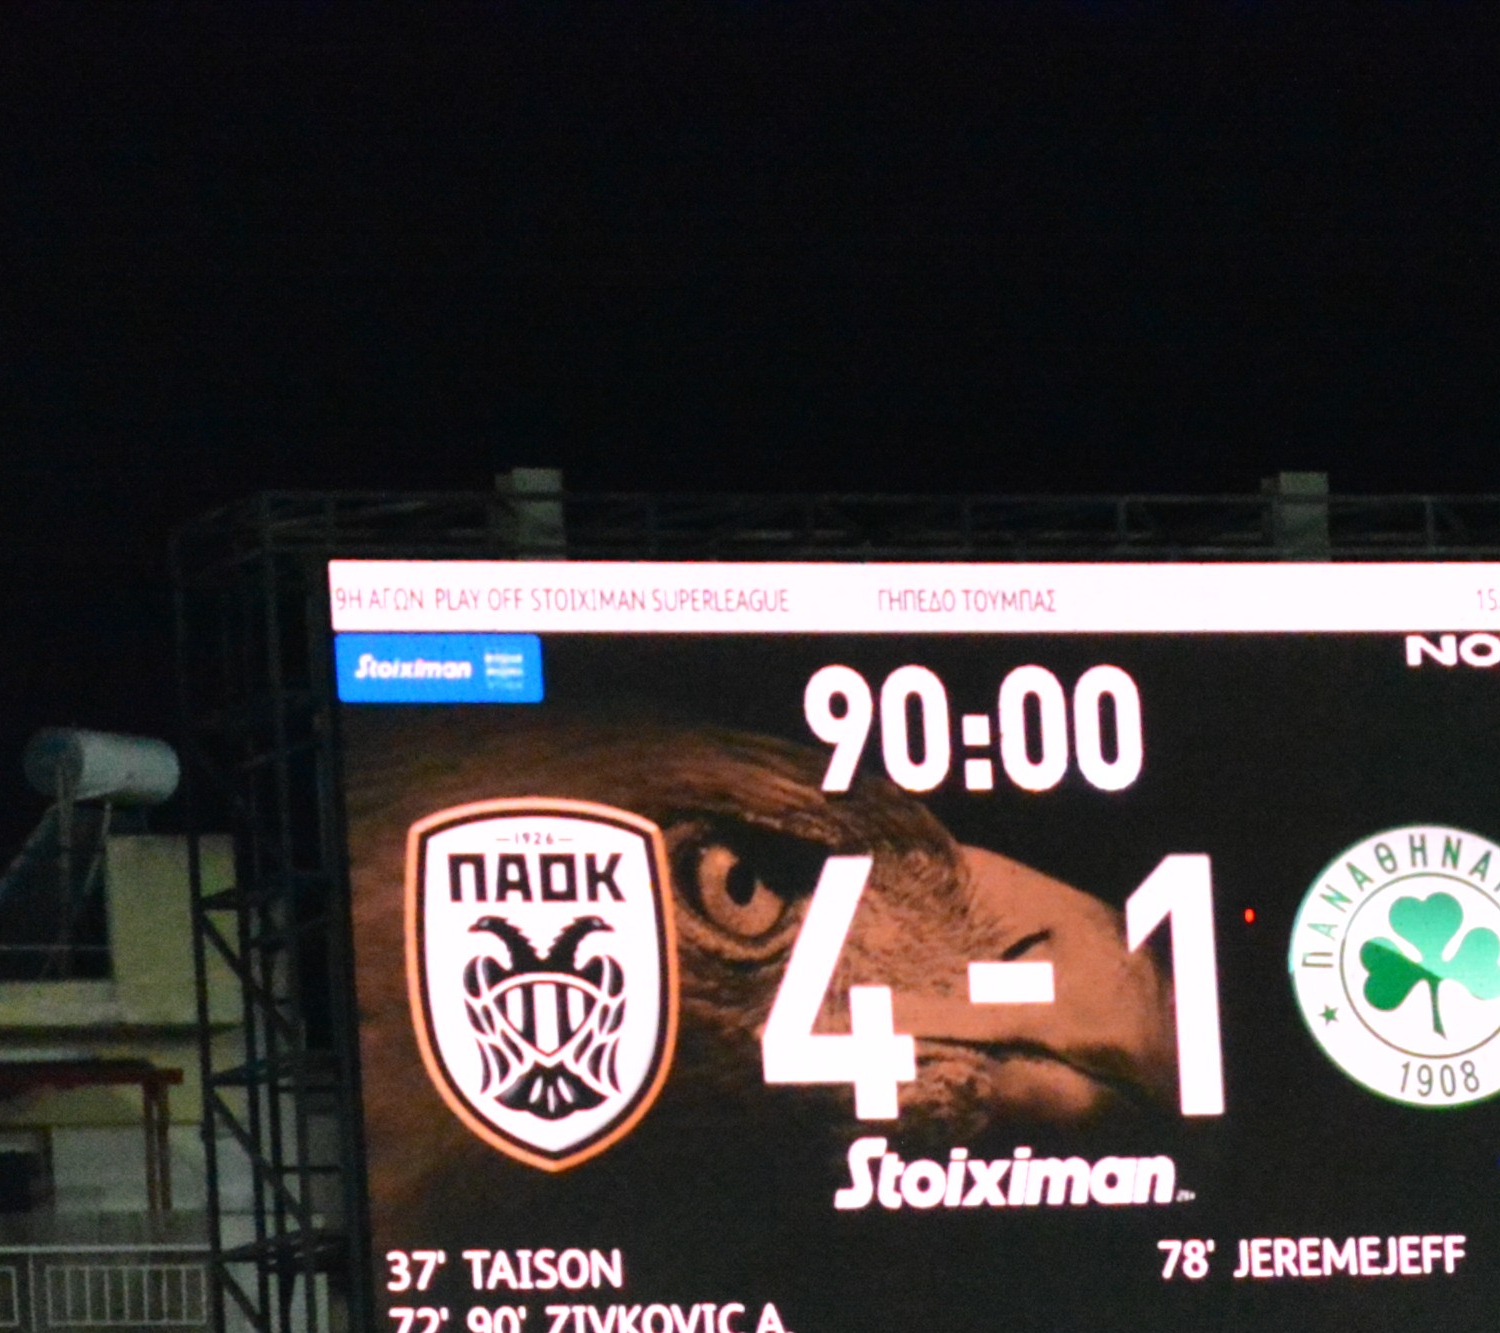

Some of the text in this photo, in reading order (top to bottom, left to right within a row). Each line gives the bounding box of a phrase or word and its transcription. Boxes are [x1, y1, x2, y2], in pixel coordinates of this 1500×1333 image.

[435, 587, 480, 611] PLAY
[488, 587, 524, 611] OFF
[531, 587, 646, 612] STOIXIMAN
[653, 588, 790, 612] SUPERLEAGUE
[877, 589, 1057, 612] ΓΗΠΕΔΟ ΤΟΥΜΠΑΣ
[354, 653, 473, 679] Stoiximan
[802, 663, 1145, 792] 90:00
[761, 855, 917, 1120] 4
[1125, 853, 1225, 1116] 1
[1400, 1059, 1480, 1097] 1908
[833, 1136, 1177, 1210] Stoiximan
[462, 1248, 624, 1290] TAISON
[1232, 1234, 1467, 1279] JEREMEJEFF
